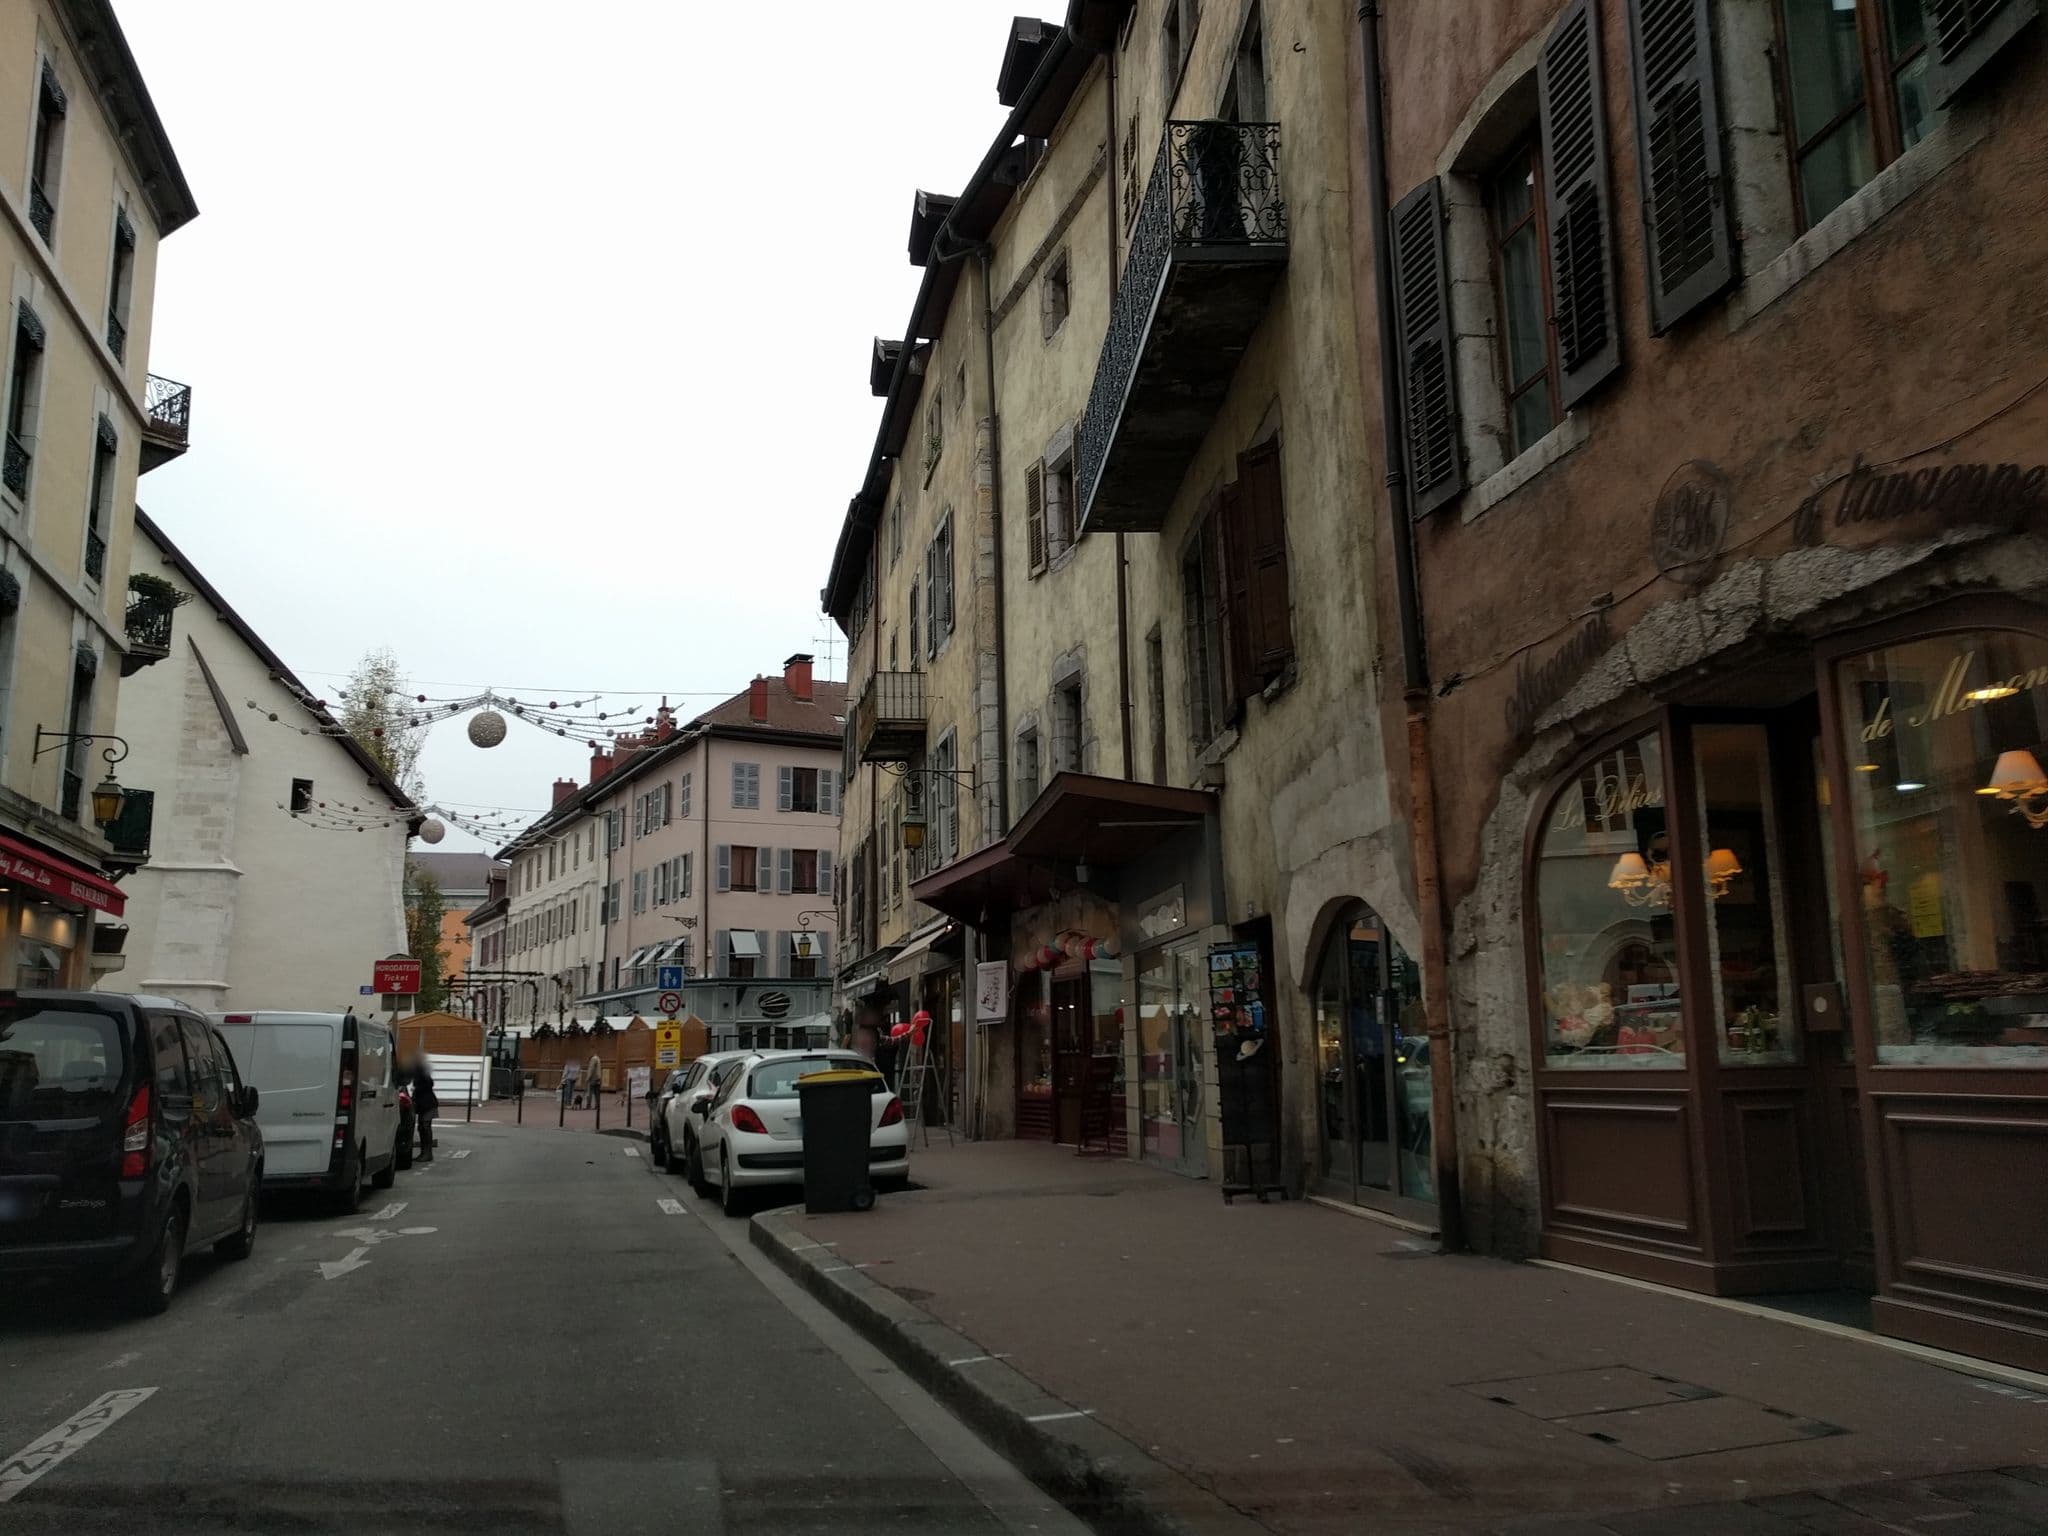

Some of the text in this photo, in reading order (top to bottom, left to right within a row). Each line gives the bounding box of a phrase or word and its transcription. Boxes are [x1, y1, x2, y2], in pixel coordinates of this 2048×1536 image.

[1859, 695, 1895, 743] de
[1907, 650, 2048, 728] Manon
[70, 880, 110, 908] RESTAURANT
[375, 963, 421, 972] HORODATEUR
[383, 974, 409, 982] Ticket
